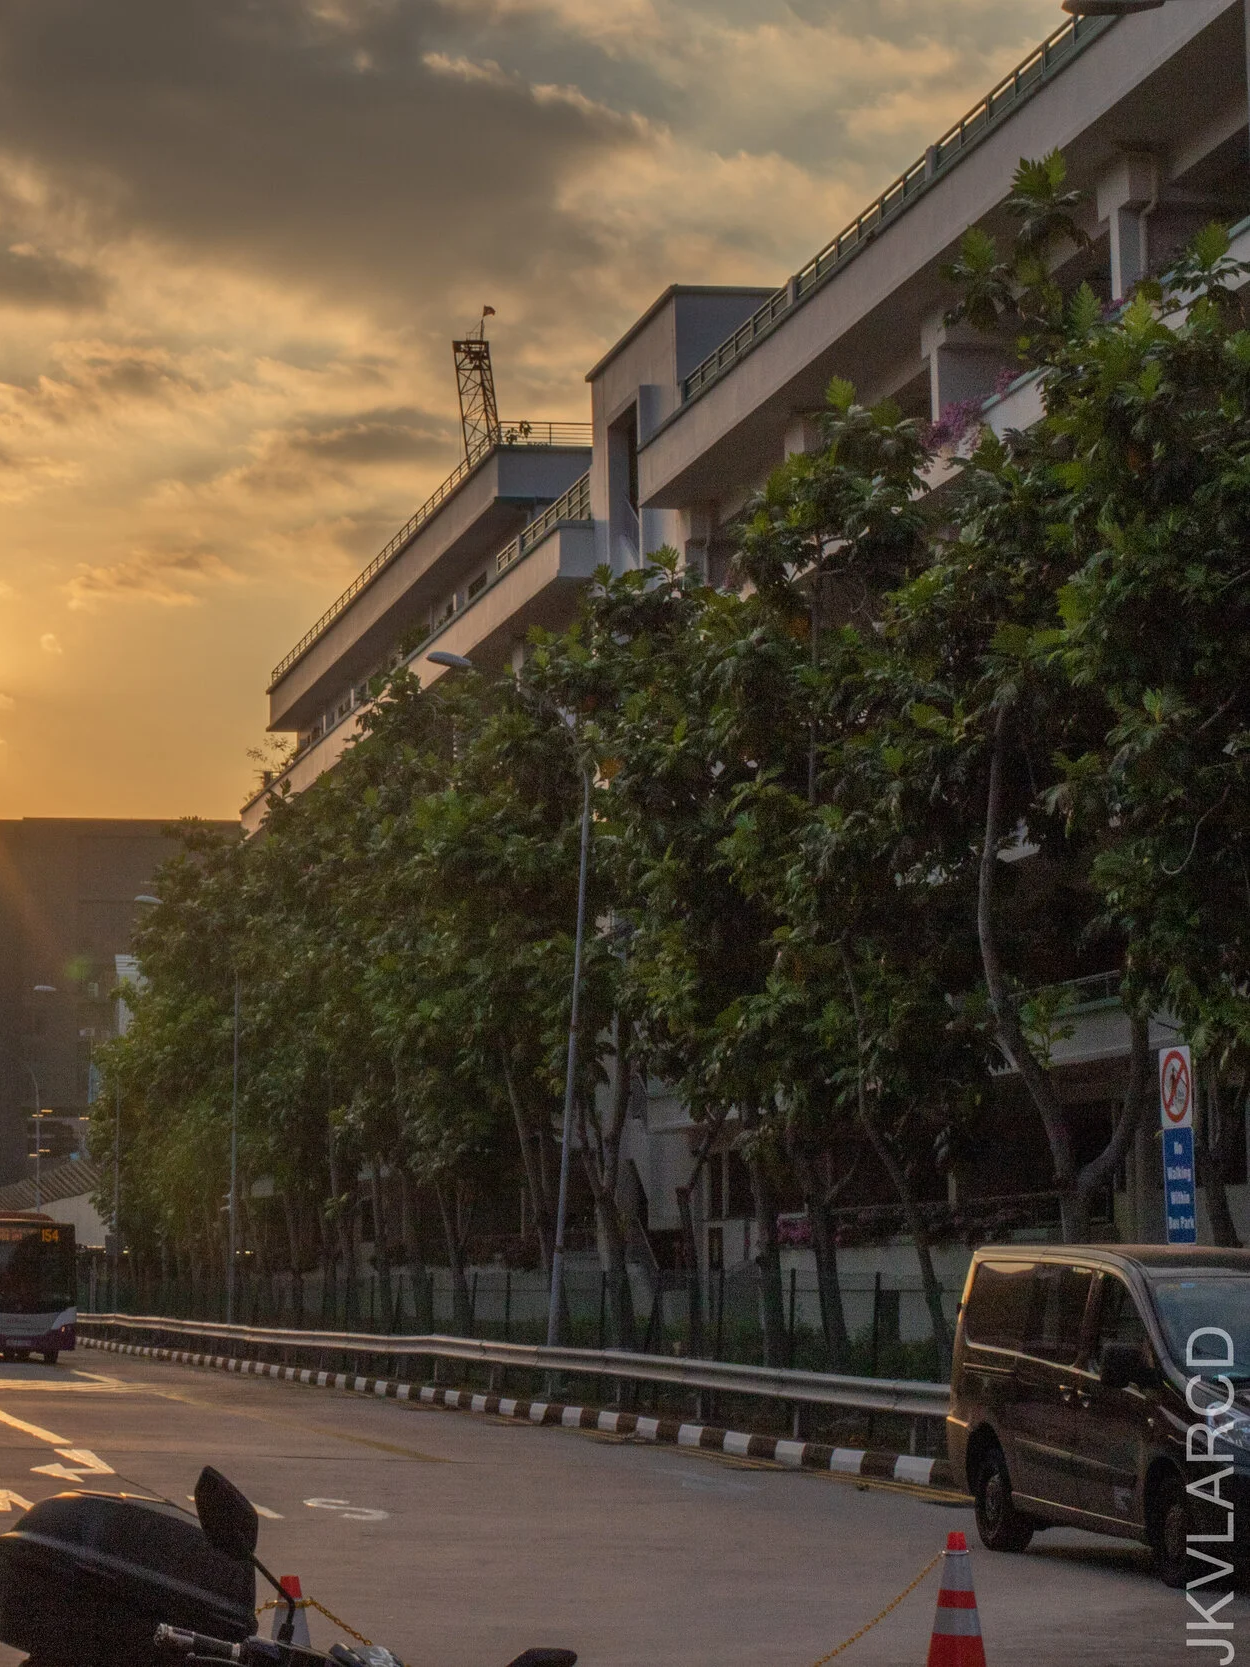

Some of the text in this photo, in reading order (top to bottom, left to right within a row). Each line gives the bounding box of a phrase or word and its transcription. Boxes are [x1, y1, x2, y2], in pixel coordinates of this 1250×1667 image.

[1167, 1166, 1191, 1181] Walking
[1168, 1216, 1194, 1229] Bus Park
[41, 1228, 59, 1242] 154
